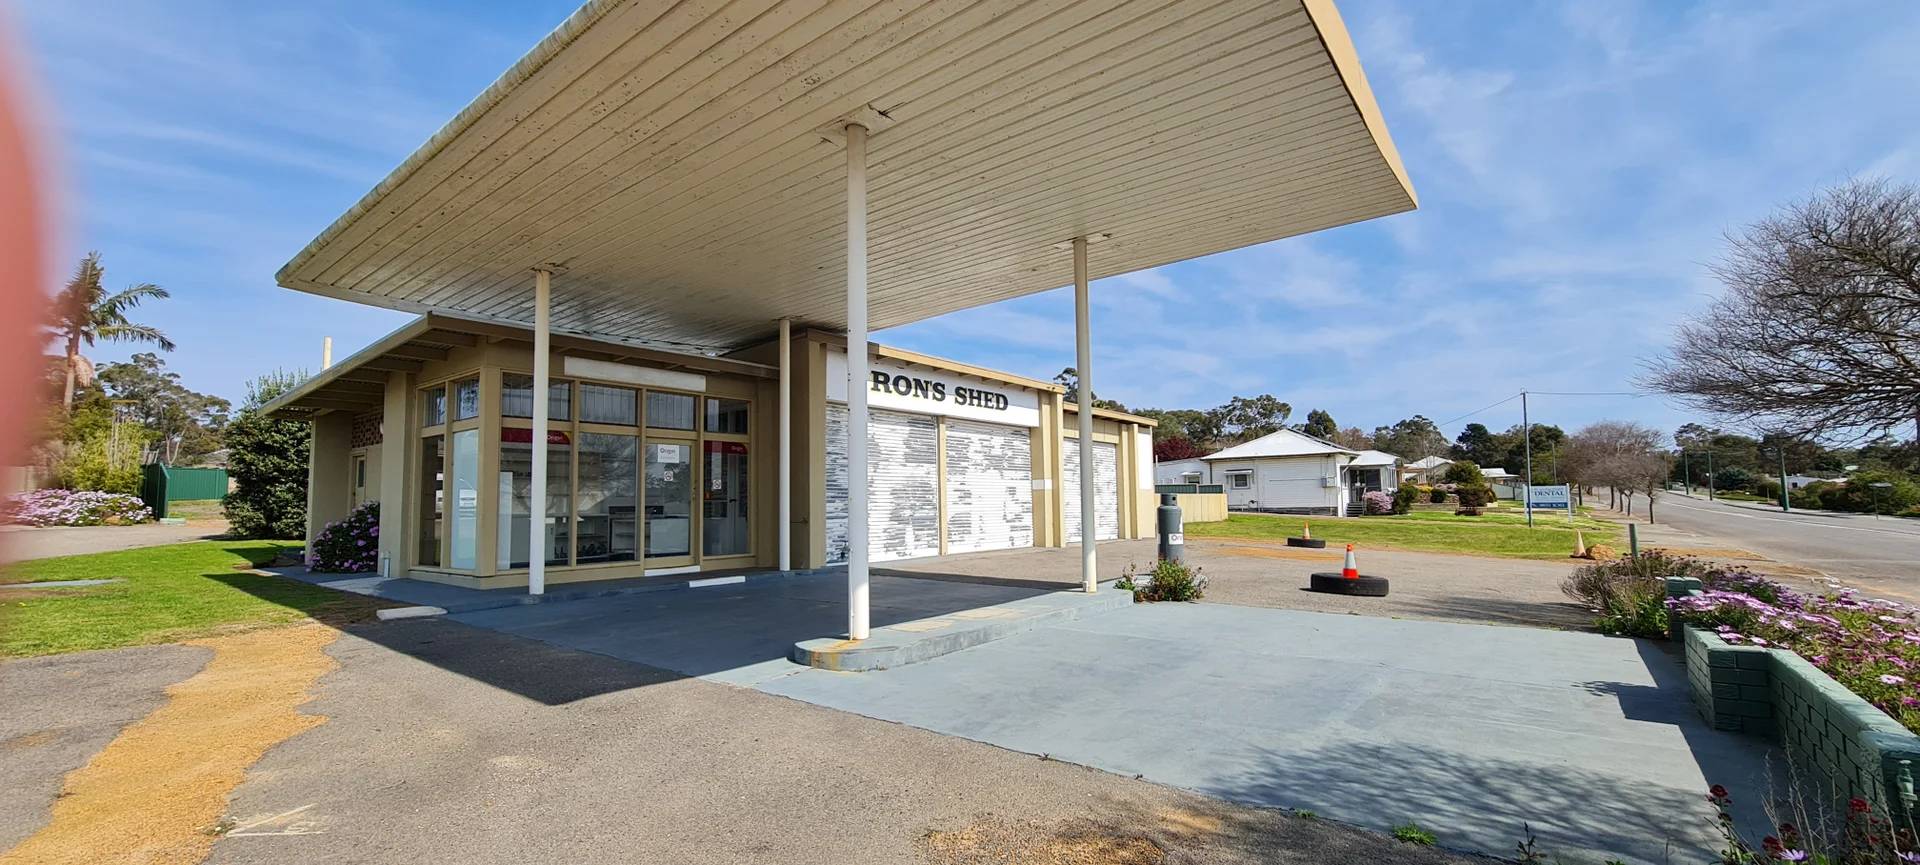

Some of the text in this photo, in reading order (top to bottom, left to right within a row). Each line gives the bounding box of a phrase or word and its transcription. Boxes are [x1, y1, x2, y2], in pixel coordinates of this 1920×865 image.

[870, 370, 1009, 411] RON'S SHED
[659, 447, 676, 455] Origin
